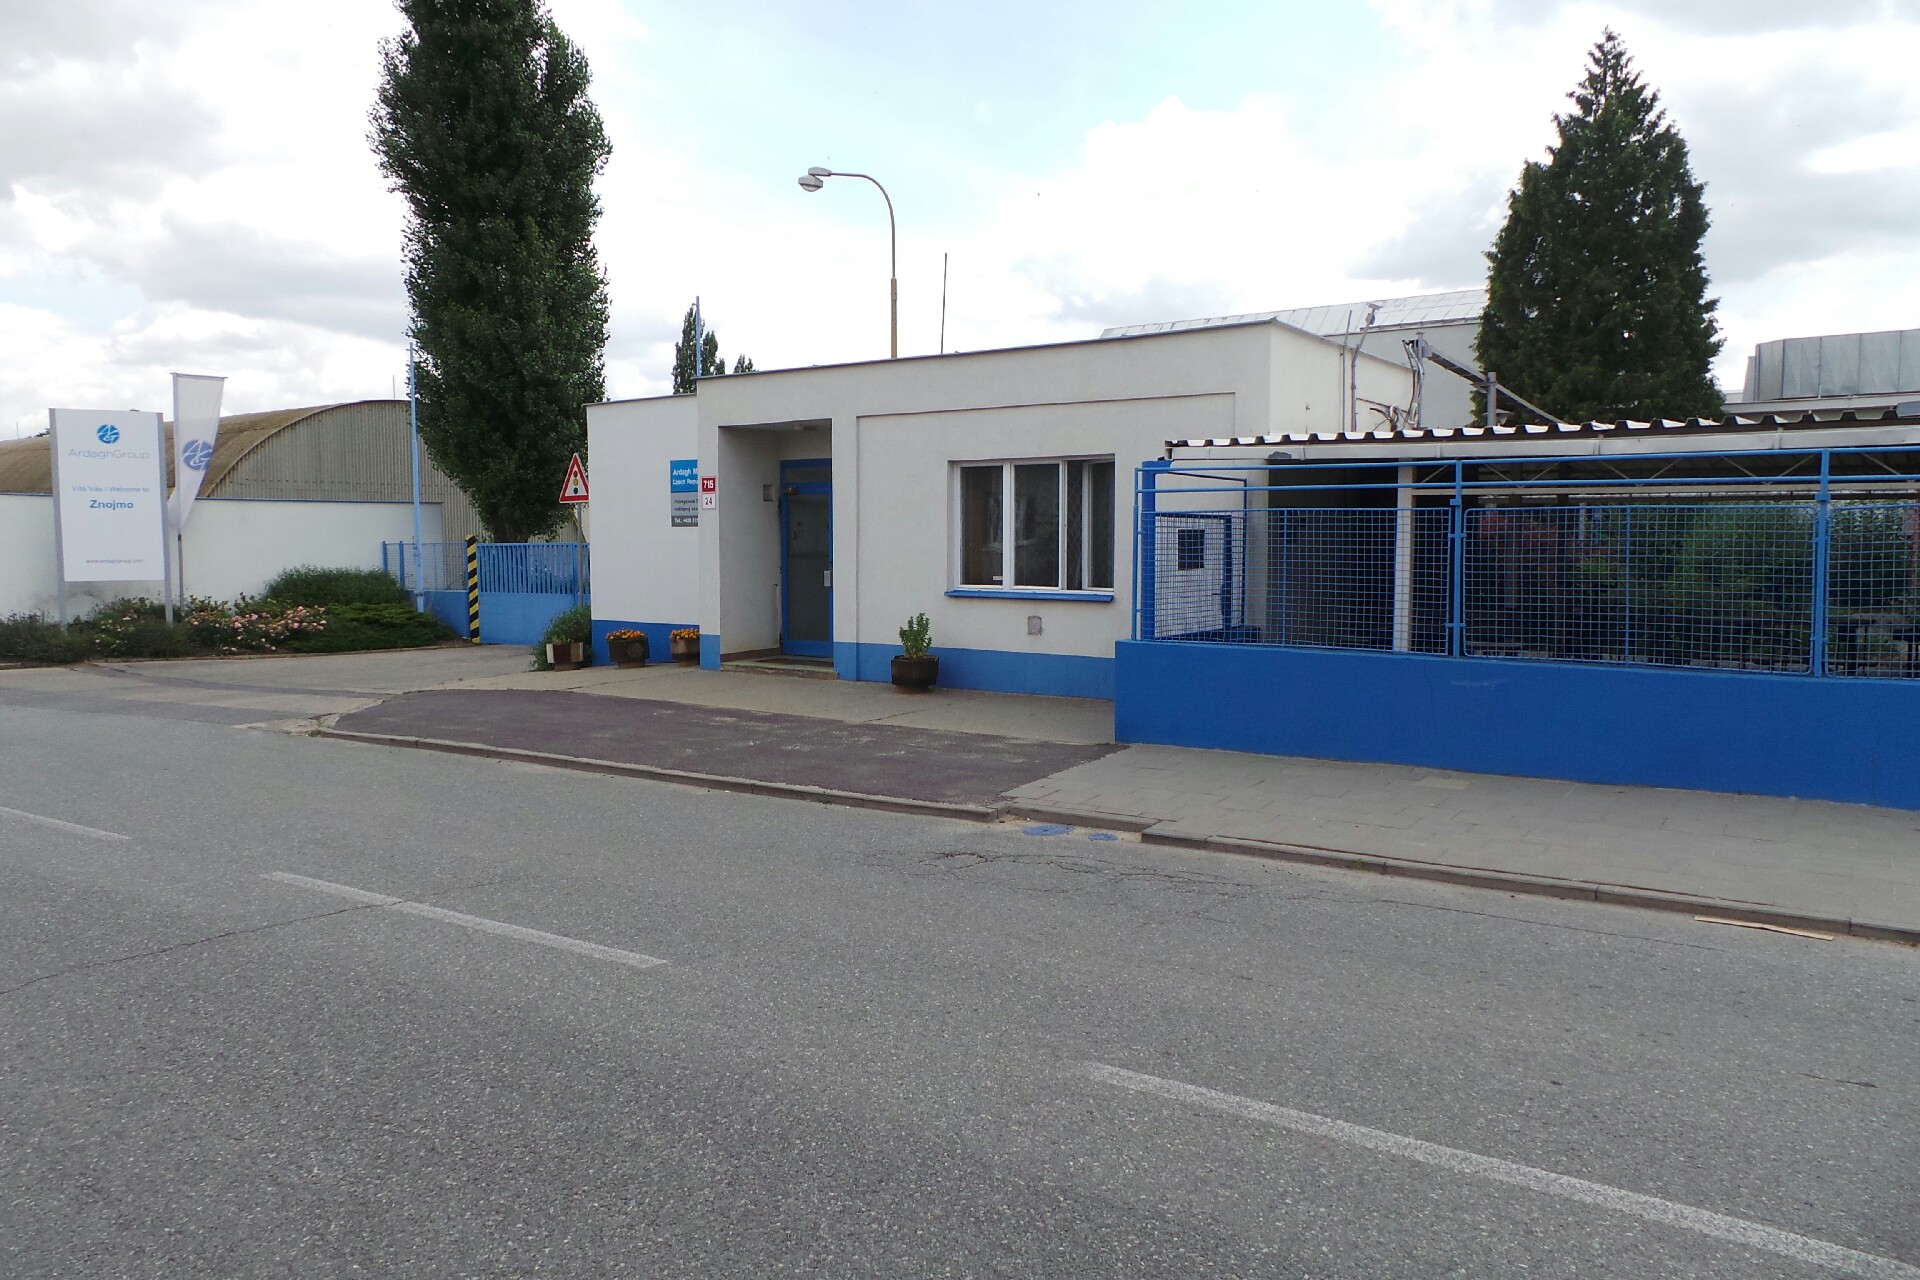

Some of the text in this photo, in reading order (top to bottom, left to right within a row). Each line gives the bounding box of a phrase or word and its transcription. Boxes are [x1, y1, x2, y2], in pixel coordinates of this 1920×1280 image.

[68, 448, 150, 460] ArdaghGroup
[672, 468, 692, 476] Ardagh
[703, 480, 714, 489] 715
[90, 499, 134, 511] Znojmo
[705, 497, 712, 505] 24
